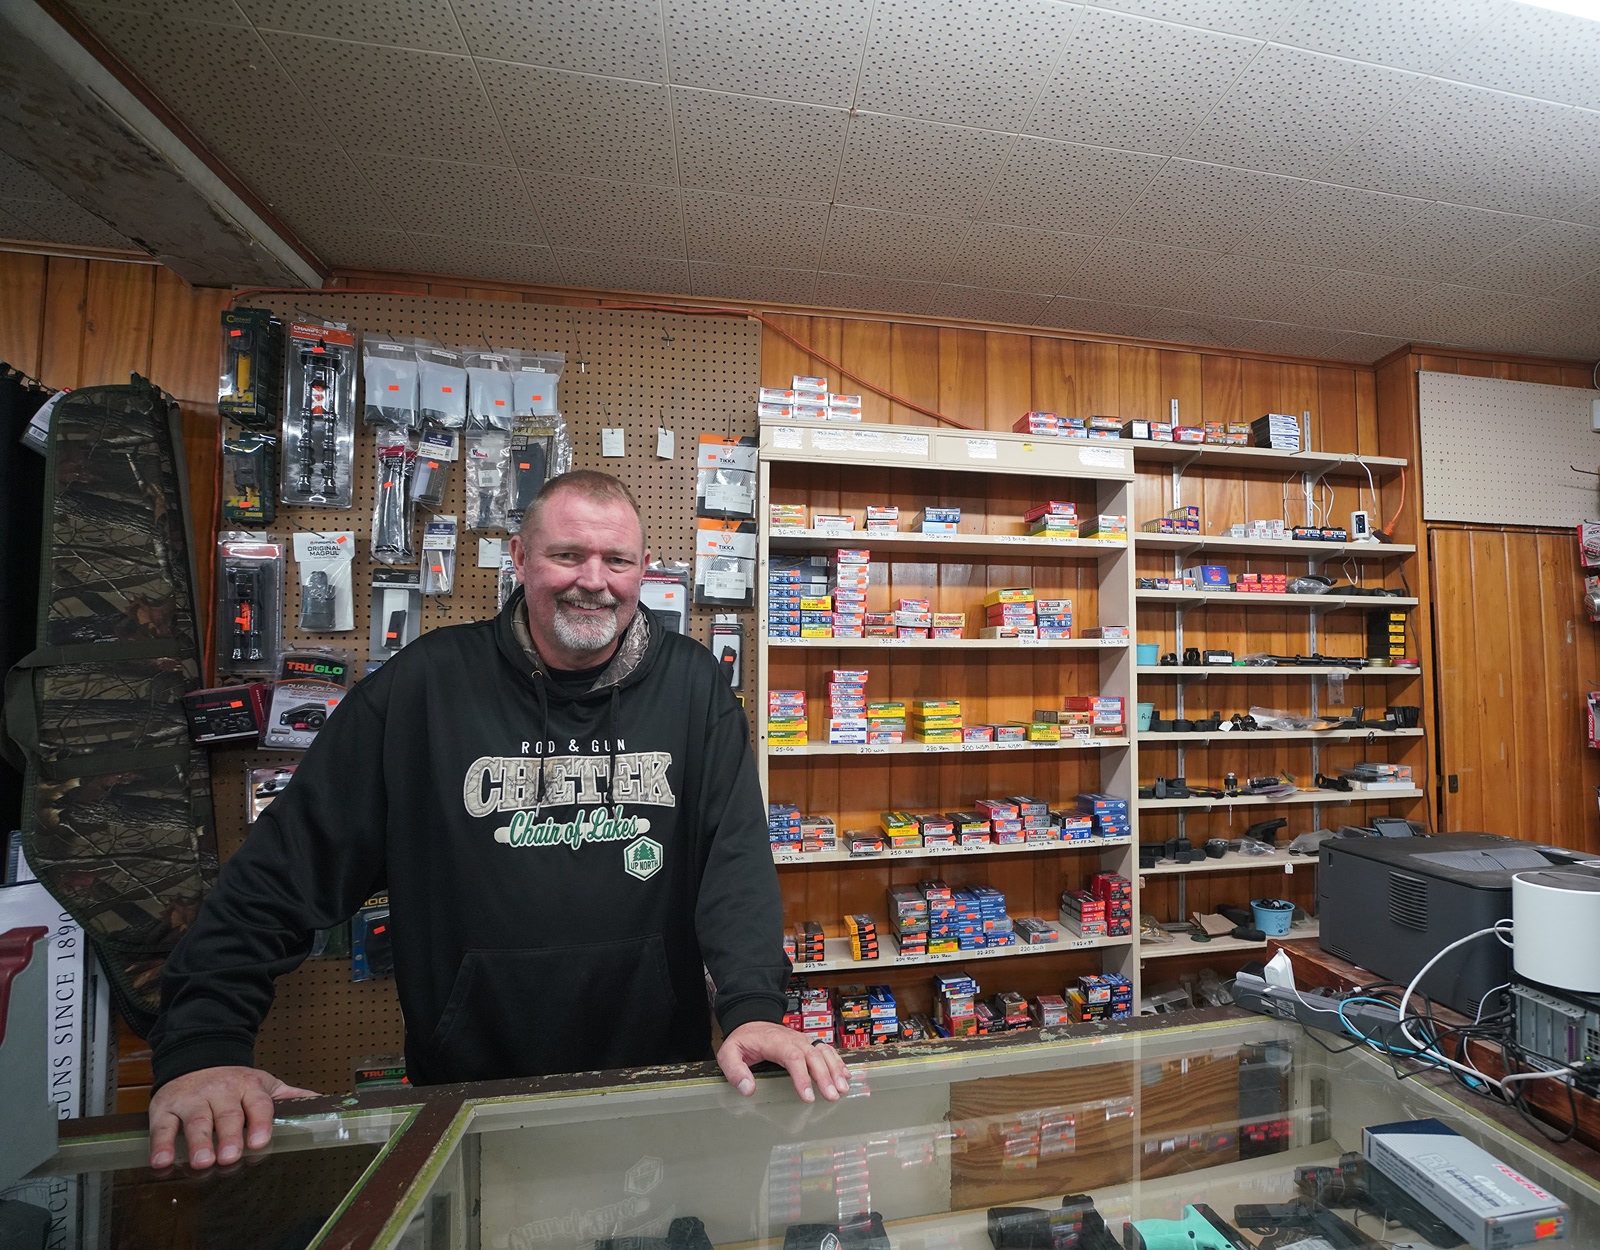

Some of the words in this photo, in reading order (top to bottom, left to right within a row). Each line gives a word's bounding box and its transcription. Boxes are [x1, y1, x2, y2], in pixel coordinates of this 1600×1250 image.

[293, 325, 329, 335] CHAMPION
[286, 661, 345, 675] TRUGLO
[521, 740, 556, 754] ROD
[568, 738, 580, 752] &
[591, 738, 626, 752] GUN
[463, 751, 676, 818] CHETEK
[509, 809, 563, 848] Chain
[563, 808, 586, 850] of
[586, 804, 639, 841] Lakes
[630, 861, 639, 870] UP
[639, 859, 659, 871] NORTH
[57, 911, 77, 962] 1890
[53, 971, 76, 1046] SINCE
[53, 1052, 72, 1120] GUNS
[363, 1068, 406, 1078] TRUGLO
[1416, 1171, 1435, 1188] BULLETS
[1494, 1163, 1550, 1201] FEDERAL
